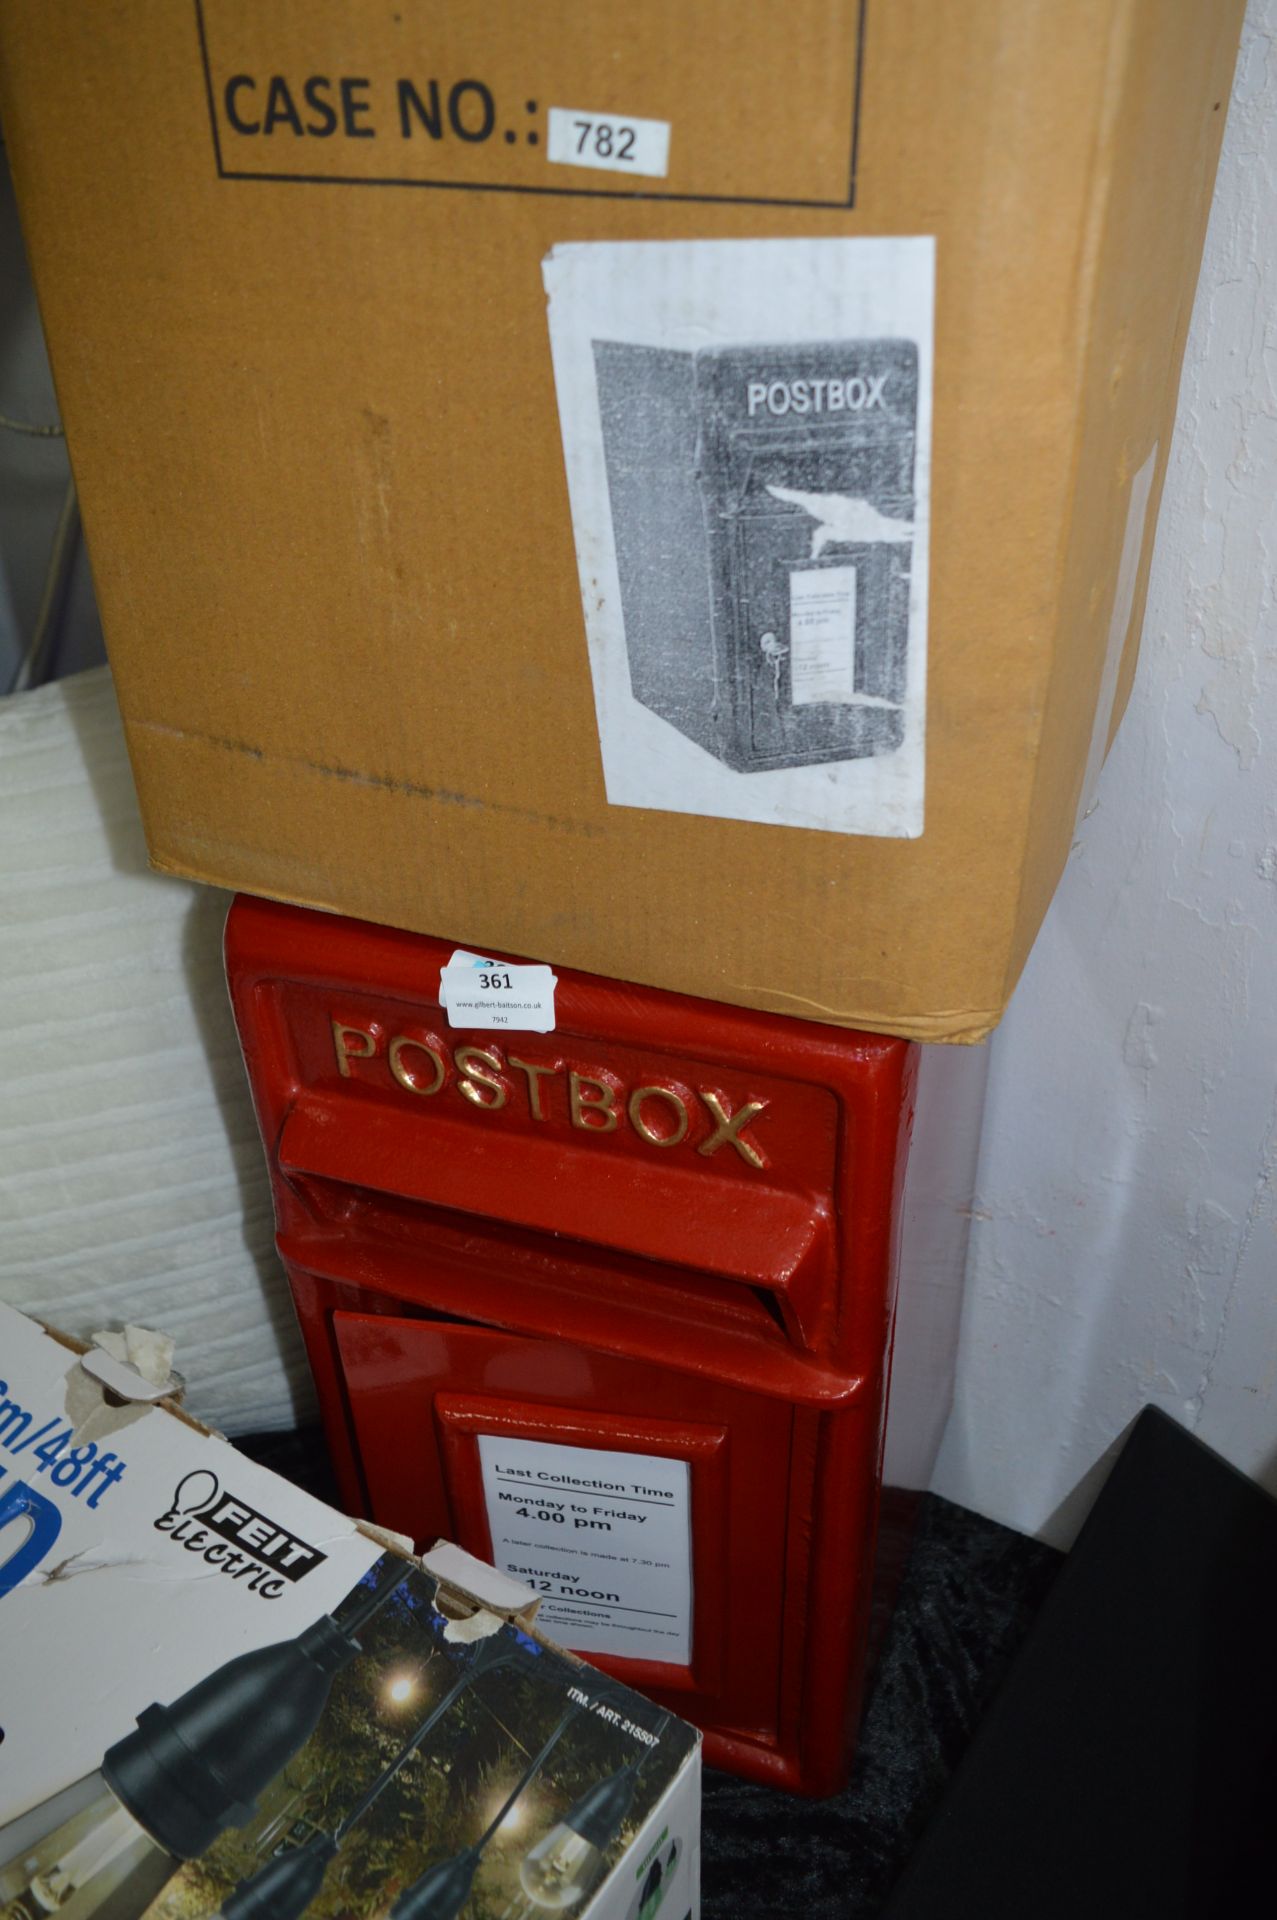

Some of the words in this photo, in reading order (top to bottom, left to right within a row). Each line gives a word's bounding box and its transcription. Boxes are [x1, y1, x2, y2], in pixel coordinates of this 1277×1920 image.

[224, 74, 375, 138] CASE
[572, 121, 636, 161] 782
[747, 370, 890, 417] POSTBOX
[478, 973, 513, 989] 361
[492, 1016, 509, 1024] 7942
[331, 1020, 769, 1169] POSTBOX
[495, 1464, 532, 1478] Last
[537, 1472, 625, 1492] Collection
[630, 1484, 674, 1499] Time
[498, 1492, 565, 1511] Monday
[571, 1504, 588, 1513] to
[593, 1507, 648, 1523] Friday
[516, 1507, 565, 1524] 4.00
[574, 1517, 612, 1531] pm
[211, 1500, 315, 1567] FEIT
[507, 1564, 580, 1583] Saturday
[526, 1579, 552, 1591] 12
[560, 1584, 620, 1602] noon
[548, 1605, 611, 1619] Collections
[567, 1686, 589, 1707] ITM.
[596, 1705, 621, 1726] ART.
[621, 1719, 660, 1748] 215507
